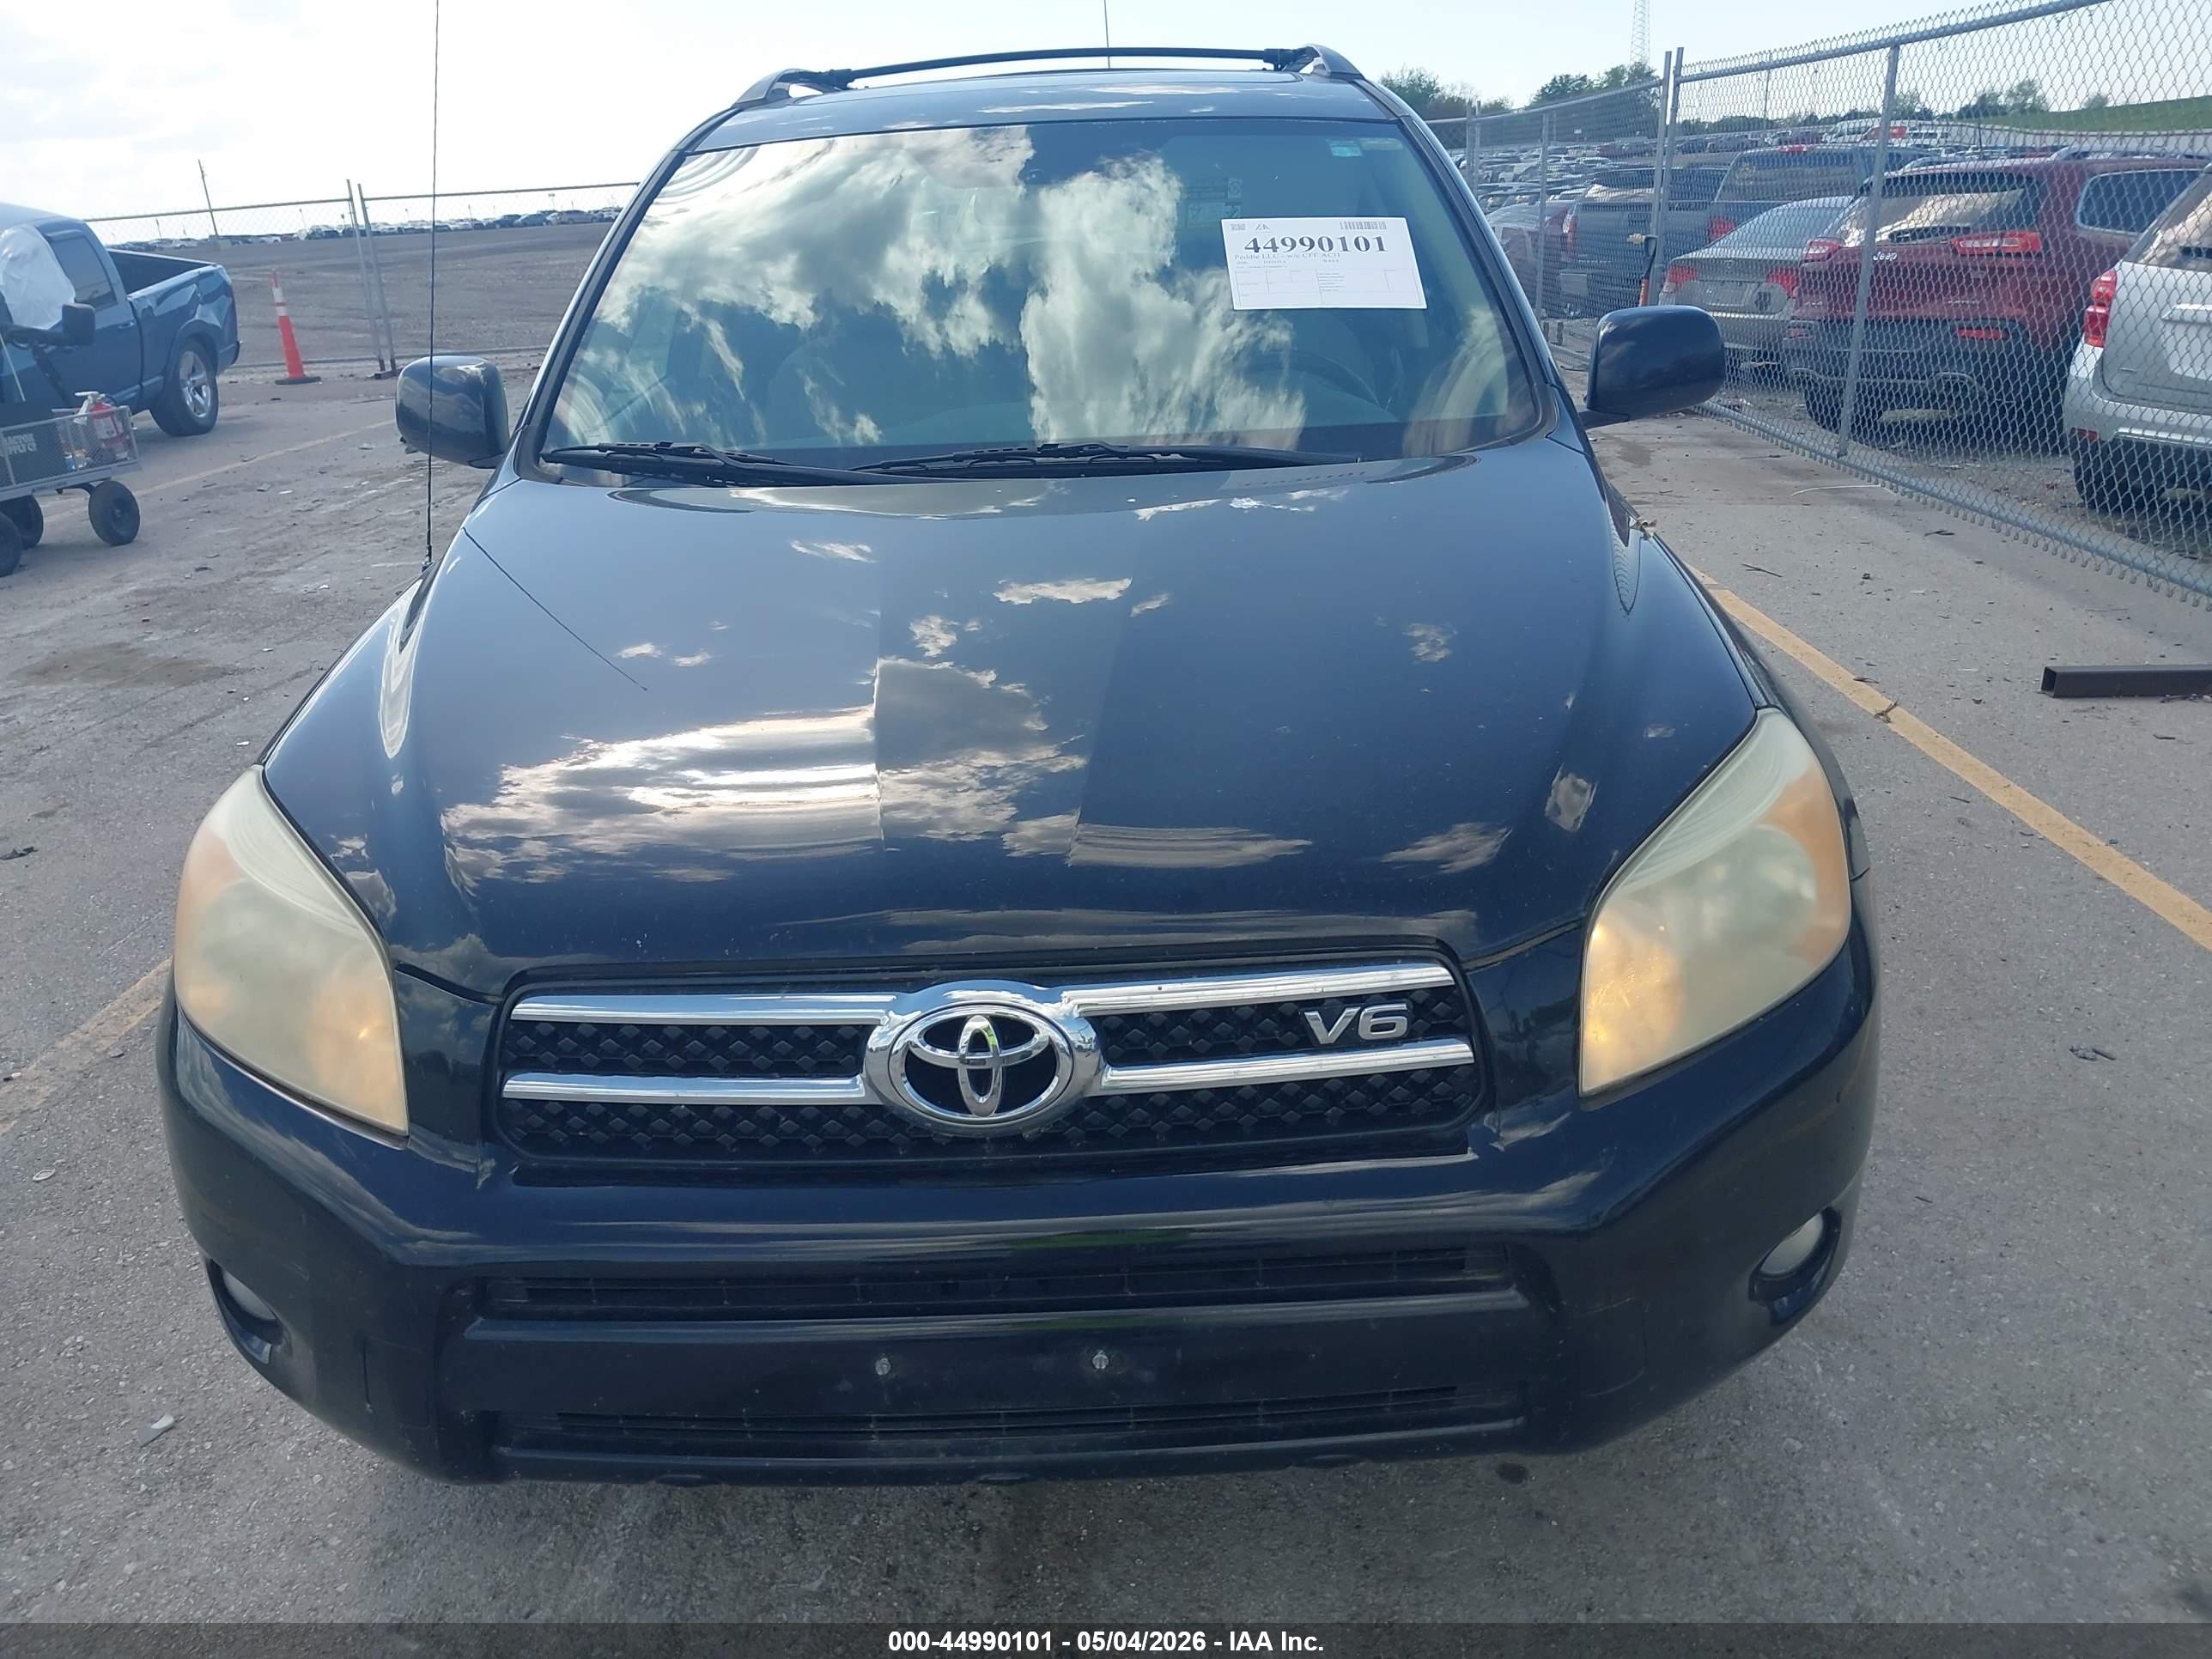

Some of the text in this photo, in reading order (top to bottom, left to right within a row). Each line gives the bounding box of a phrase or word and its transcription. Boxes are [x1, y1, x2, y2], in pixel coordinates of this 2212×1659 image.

[1244, 235, 1388, 253] 44990101
[1873, 251, 1898, 262] Jeep
[1304, 1003, 1408, 1045] V6
